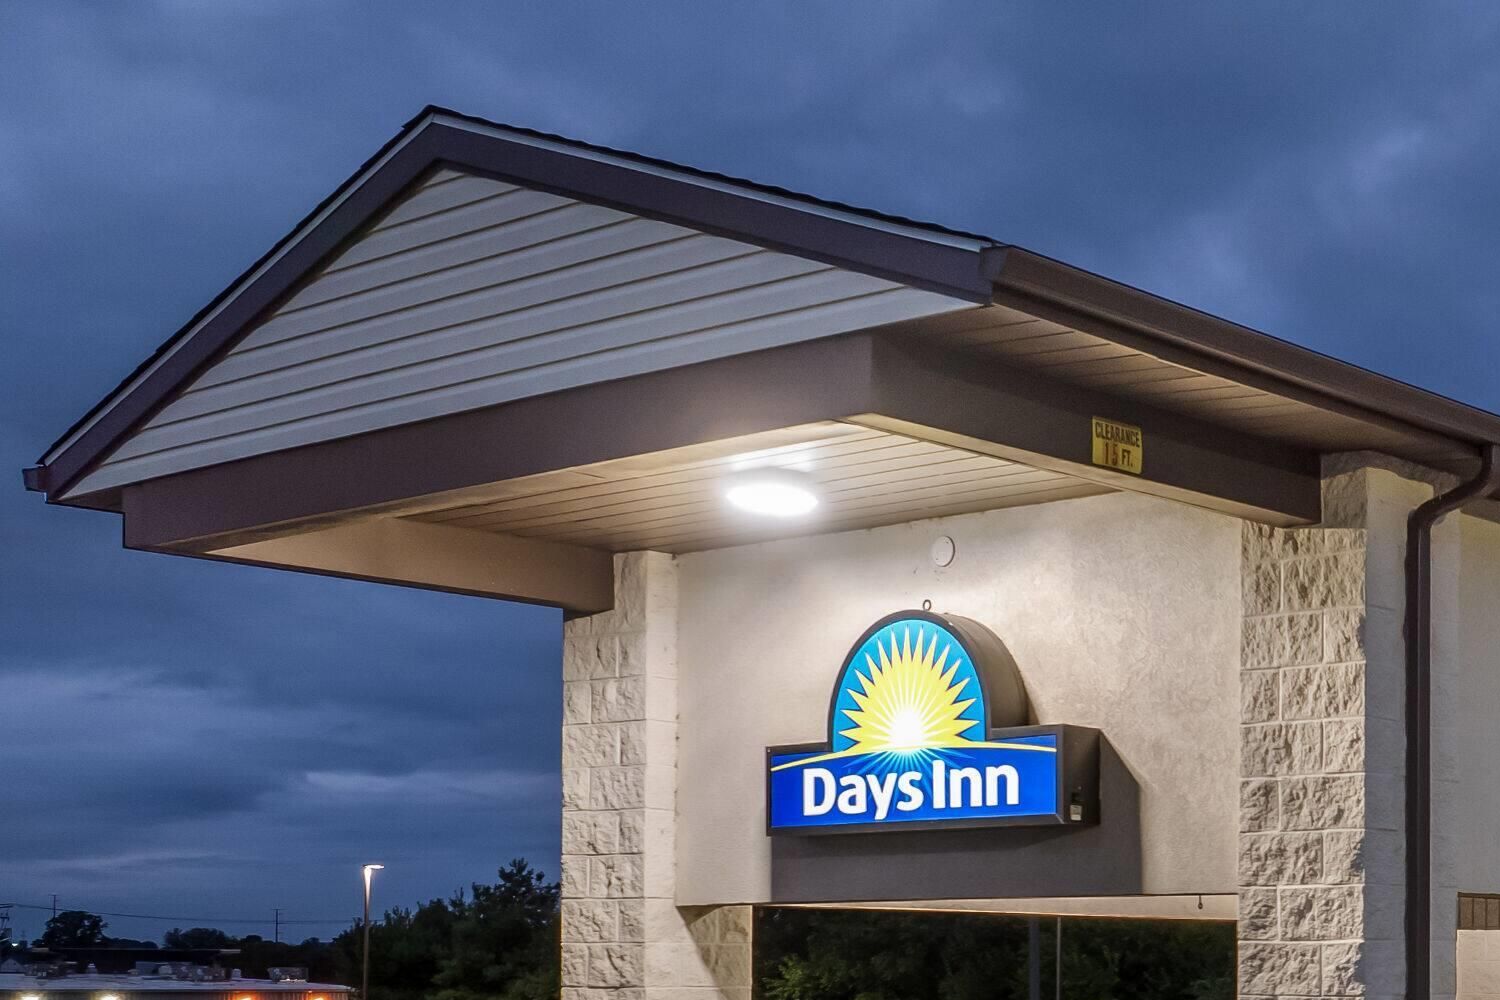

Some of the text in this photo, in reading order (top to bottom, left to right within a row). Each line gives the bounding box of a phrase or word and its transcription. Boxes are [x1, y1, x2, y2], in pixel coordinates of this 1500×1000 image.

[1095, 421, 1140, 448] CLEARANCE
[803, 760, 1019, 820] Days Inn
